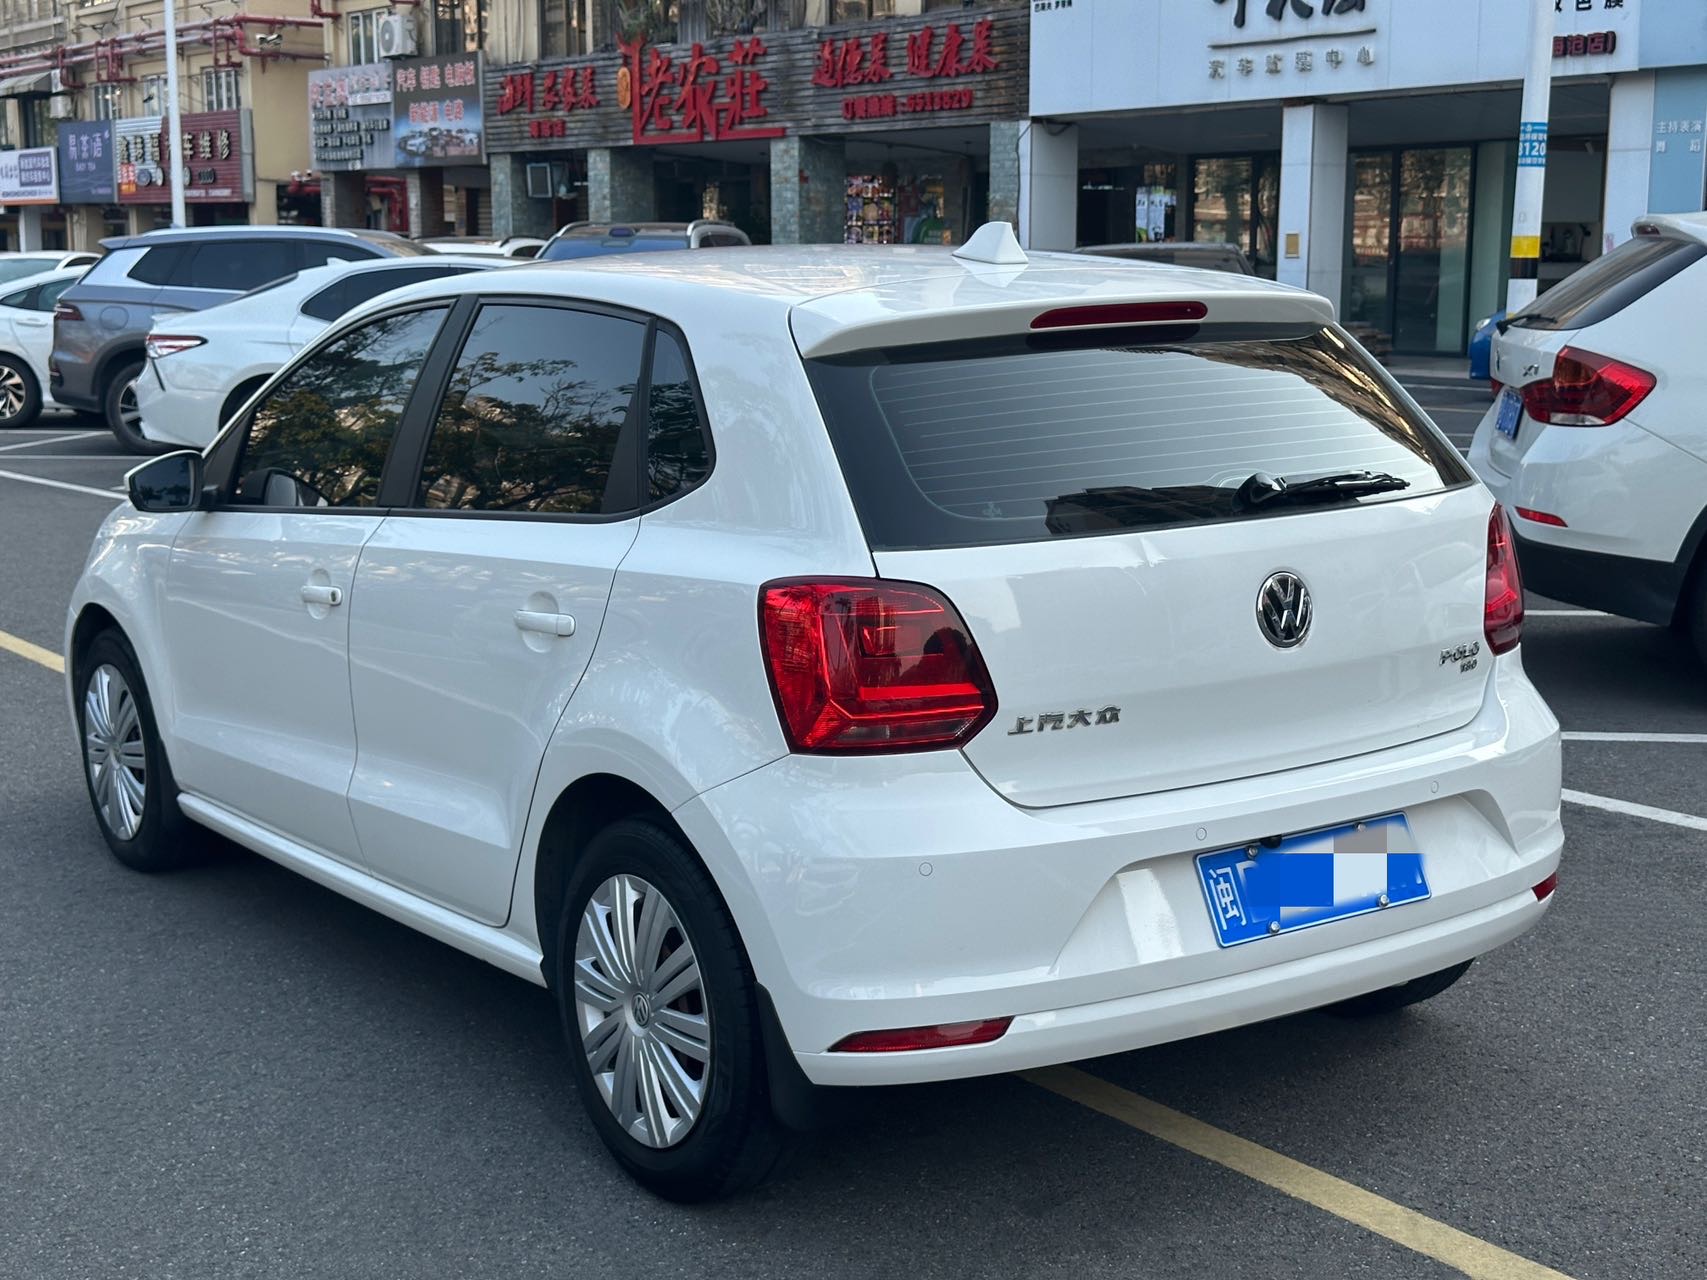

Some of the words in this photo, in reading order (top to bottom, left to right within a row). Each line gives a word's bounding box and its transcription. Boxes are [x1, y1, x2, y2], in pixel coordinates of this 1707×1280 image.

[1439, 641, 1480, 666] POLO
[1007, 704, 1122, 736] 上汽大众
